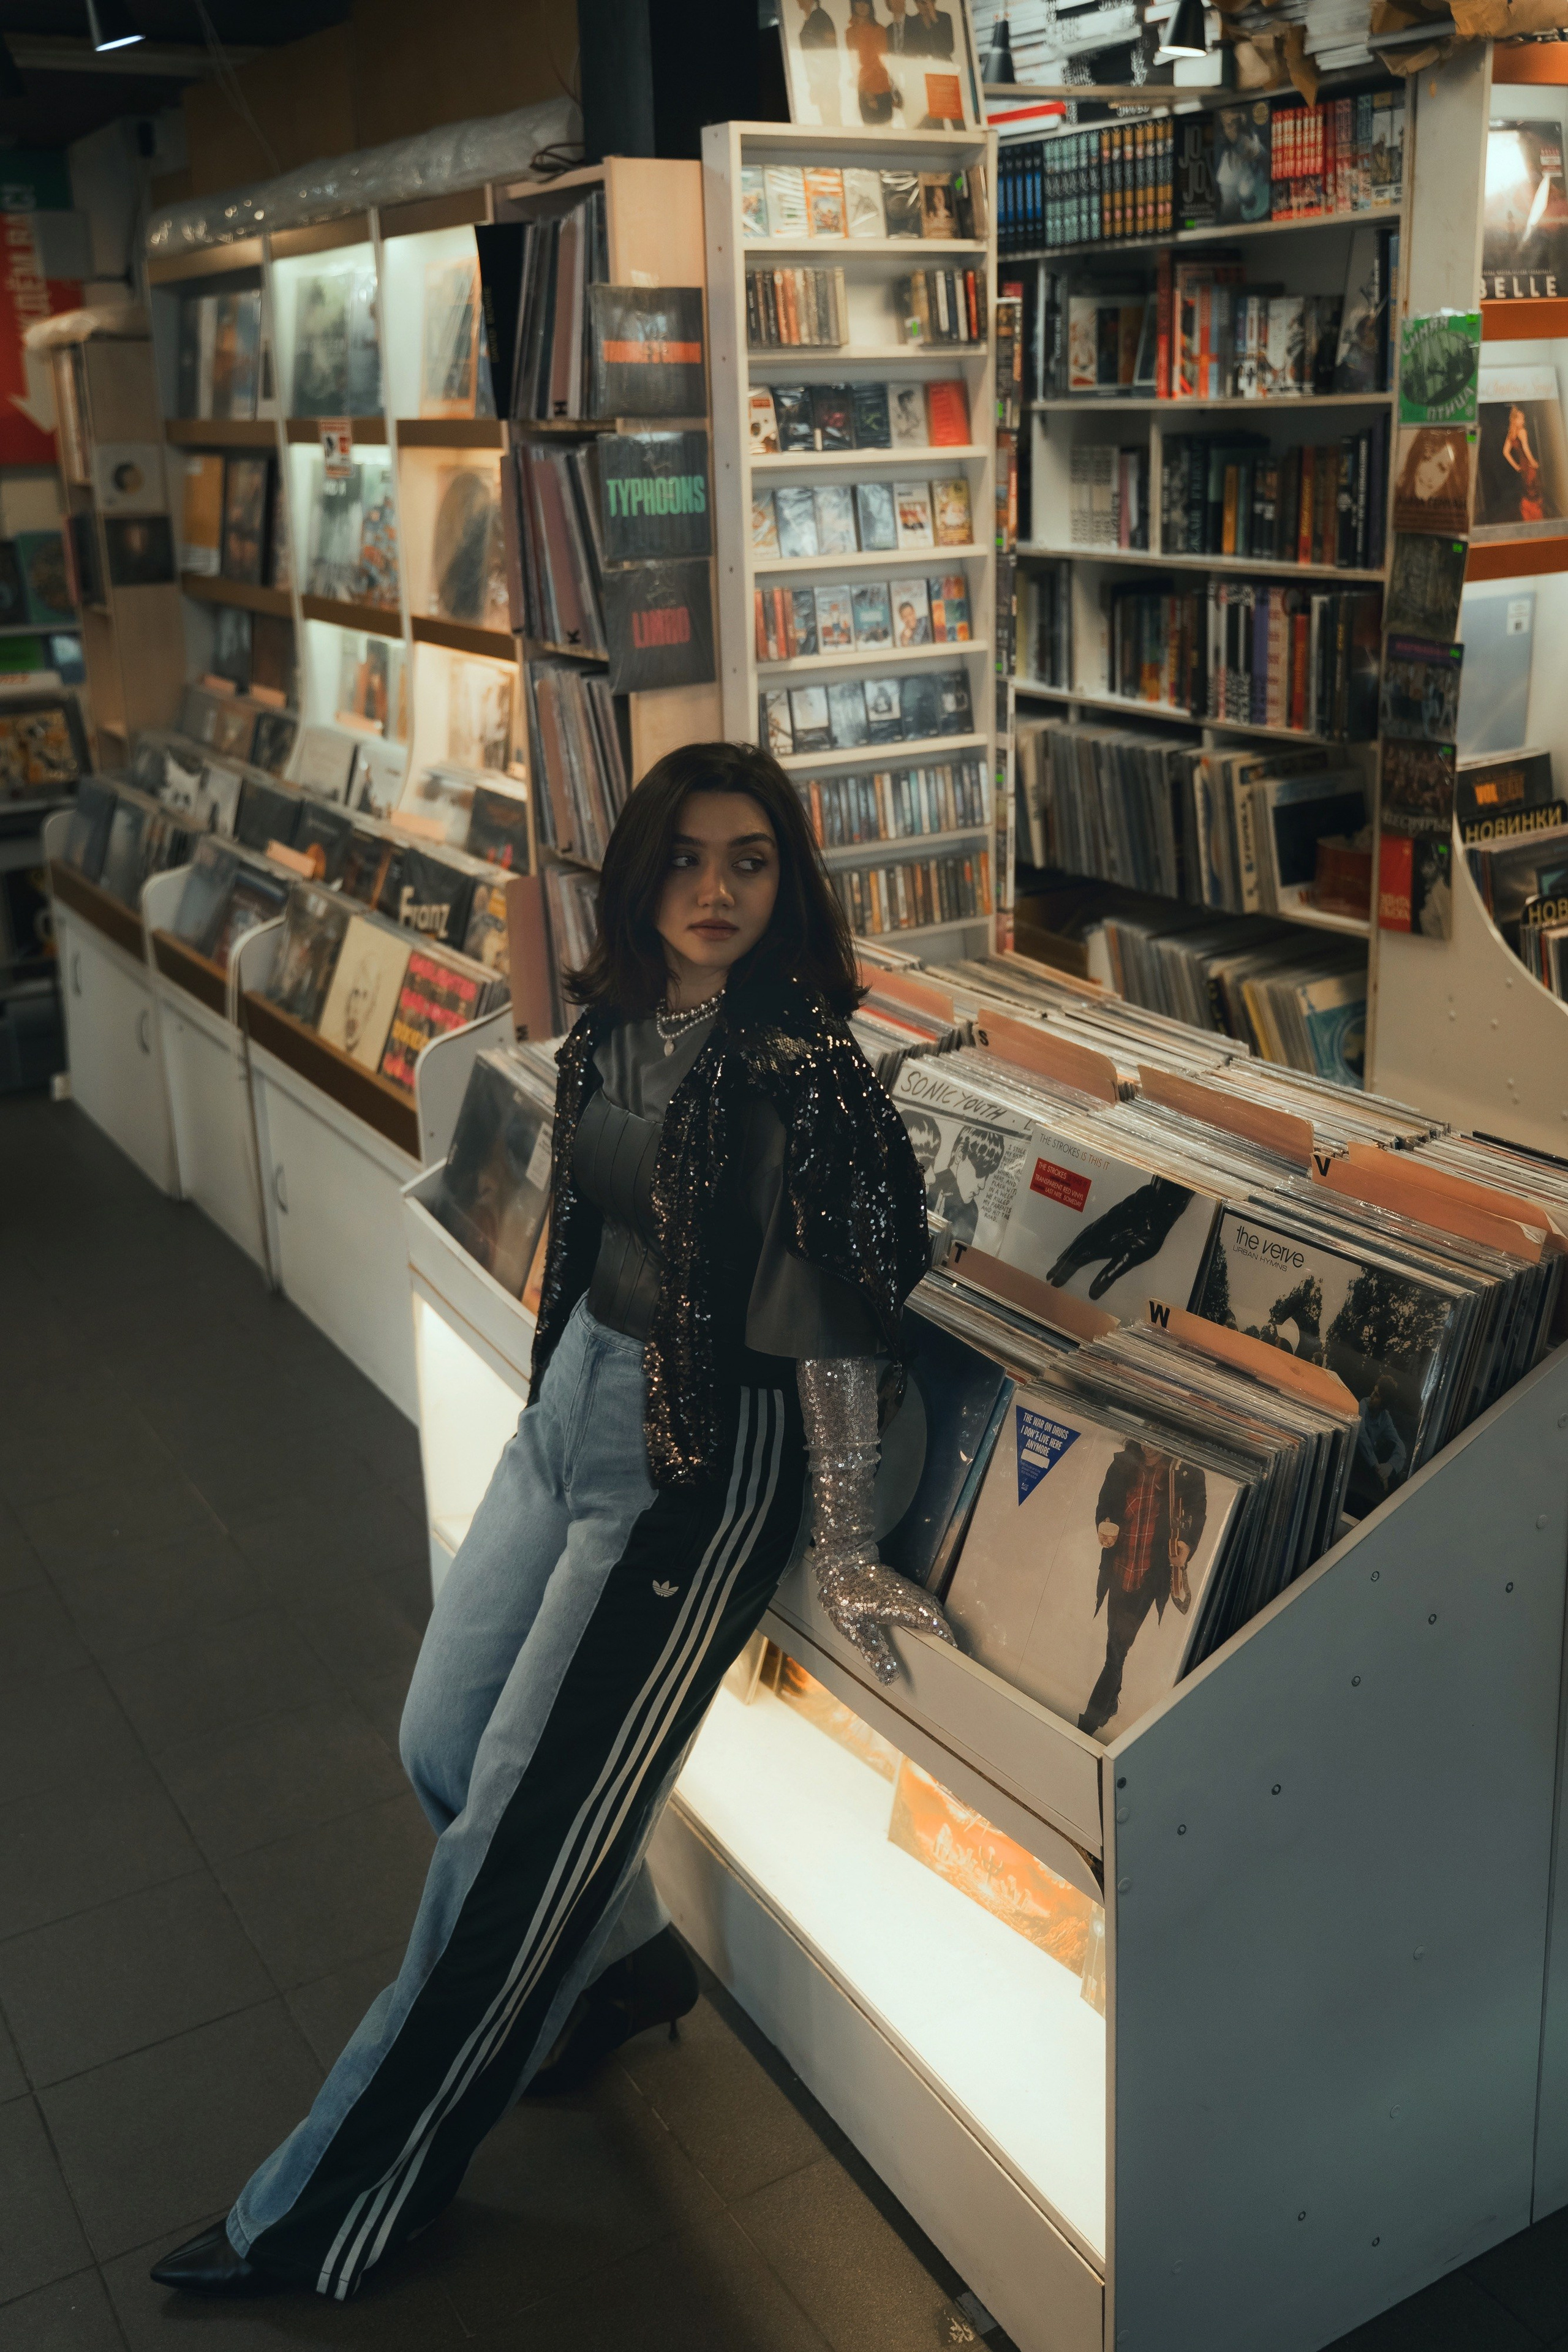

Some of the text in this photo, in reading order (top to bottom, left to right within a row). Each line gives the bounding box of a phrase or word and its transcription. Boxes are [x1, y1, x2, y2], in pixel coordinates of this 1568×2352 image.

[606, 475, 706, 518] TYPHOONS
[1465, 805, 1562, 843] НОВИНКИ
[978, 1030, 989, 1046] S
[901, 1071, 1008, 1120] SONIC YOUTH
[1039, 1133, 1110, 1170] THE STROKES IS THIS IT
[1047, 1166, 1067, 1180] STROKES
[1313, 1154, 1331, 1177] V
[1035, 1174, 1063, 1191] TRANSPARENT
[1072, 1189, 1084, 1200] VINYL
[1054, 1190, 1063, 1199] NITE
[1063, 1195, 1082, 1207] SOMEDAY
[990, 1201, 1012, 1214] PARENTS
[993, 1196, 1010, 1205] KILLED
[955, 1242, 967, 1263] T
[1232, 1245, 1287, 1272] URBAN HYMNS
[1237, 1226, 1305, 1268] the verve
[1149, 1300, 1170, 1329] W
[1020, 1425, 1063, 1451] I DON'T LIVE HERE
[1023, 1412, 1069, 1440] THE WAR ON DRUGS
[1025, 1439, 1050, 1457] ANYMORE
